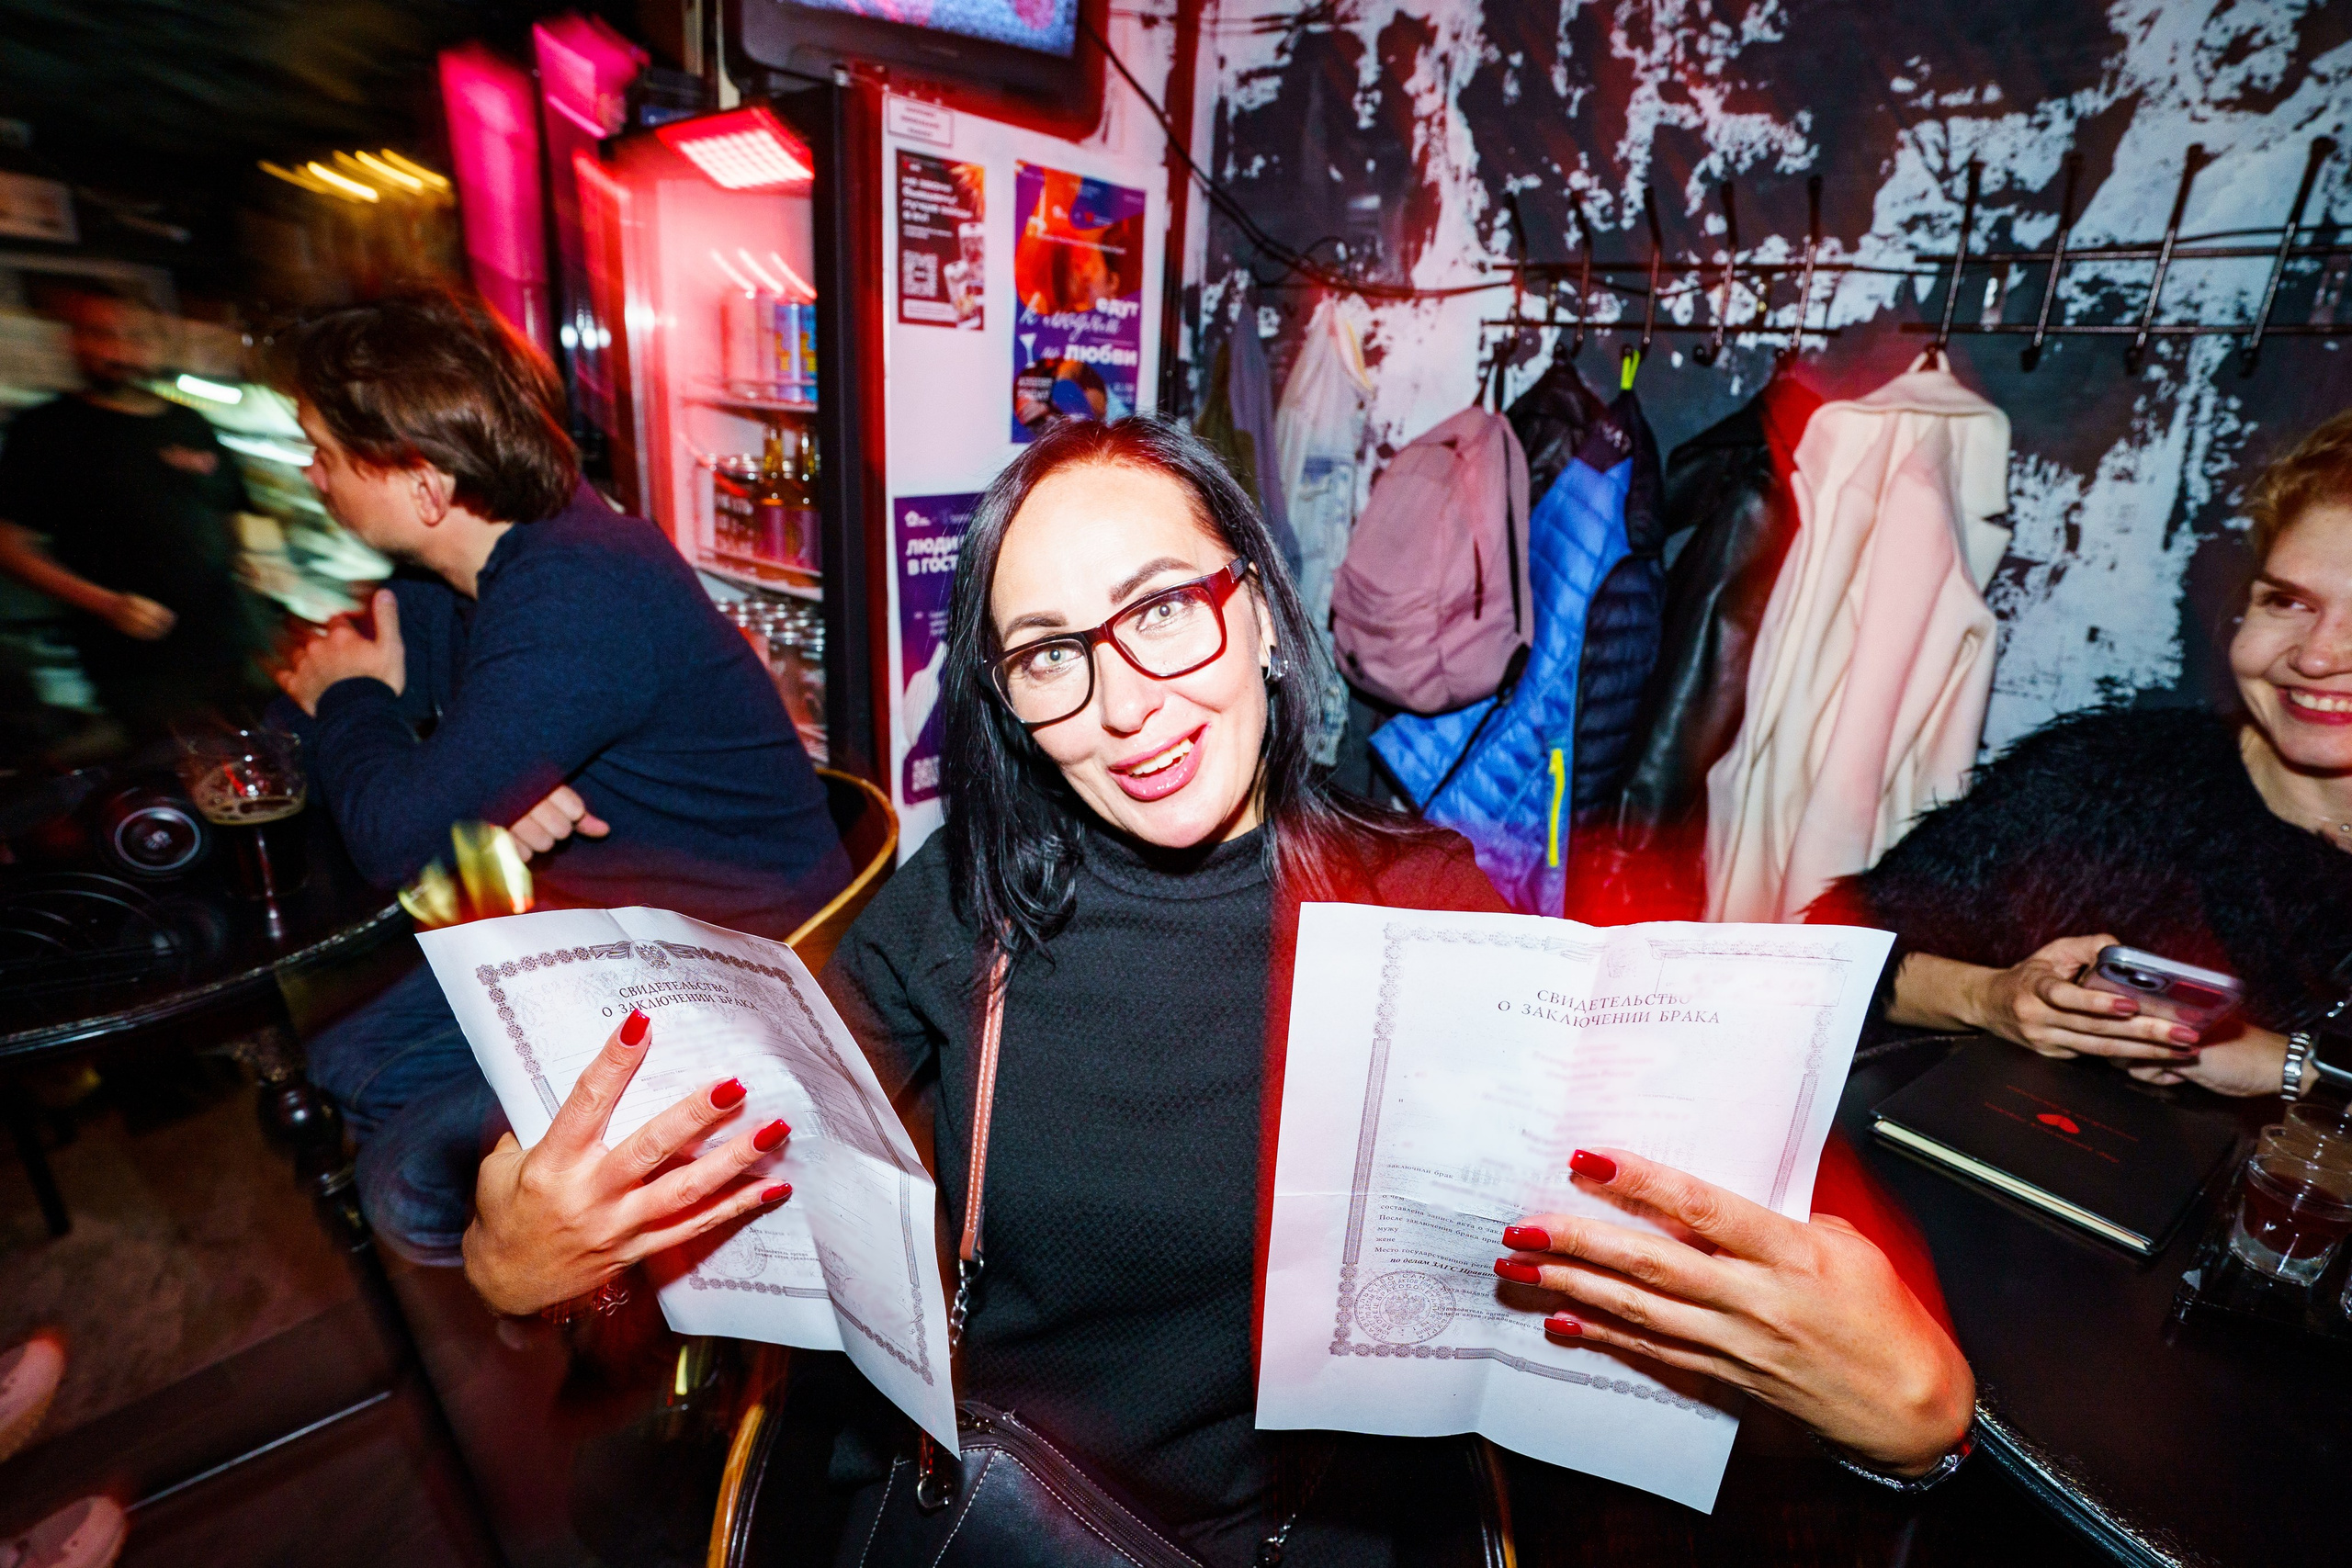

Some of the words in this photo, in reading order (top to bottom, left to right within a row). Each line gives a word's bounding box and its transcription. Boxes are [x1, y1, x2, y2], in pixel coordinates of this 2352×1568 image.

[618, 980, 729, 998] СВИДЕТЕЛЬСТВО
[601, 1006, 613, 1018] О
[618, 992, 716, 1014] ЗАКЛЮЧЕНИИ
[720, 994, 759, 1011] БРАКА
[1536, 989, 1692, 1014] СВИДЕТЕЛЬСТВО
[1498, 999, 1511, 1012] О
[1521, 1002, 1651, 1029] ЗАКЛЮЧЕНИИ
[1657, 1010, 1721, 1024] БРАКА
[1386, 1164, 1431, 1174] заключили
[1434, 1169, 1453, 1179] брак
[1380, 1205, 1424, 1215] составлена
[1427, 1213, 1453, 1224] запись
[1456, 1220, 1476, 1230] акта
[1486, 1227, 1504, 1236] закл
[1455, 1228, 1479, 1241] брака
[1481, 1235, 1502, 1246] прис
[1401, 1247, 1469, 1267] государственной
[1470, 1262, 1494, 1271] регис
[1402, 1256, 1430, 1266] делам
[1458, 1268, 1498, 1279] Правит
